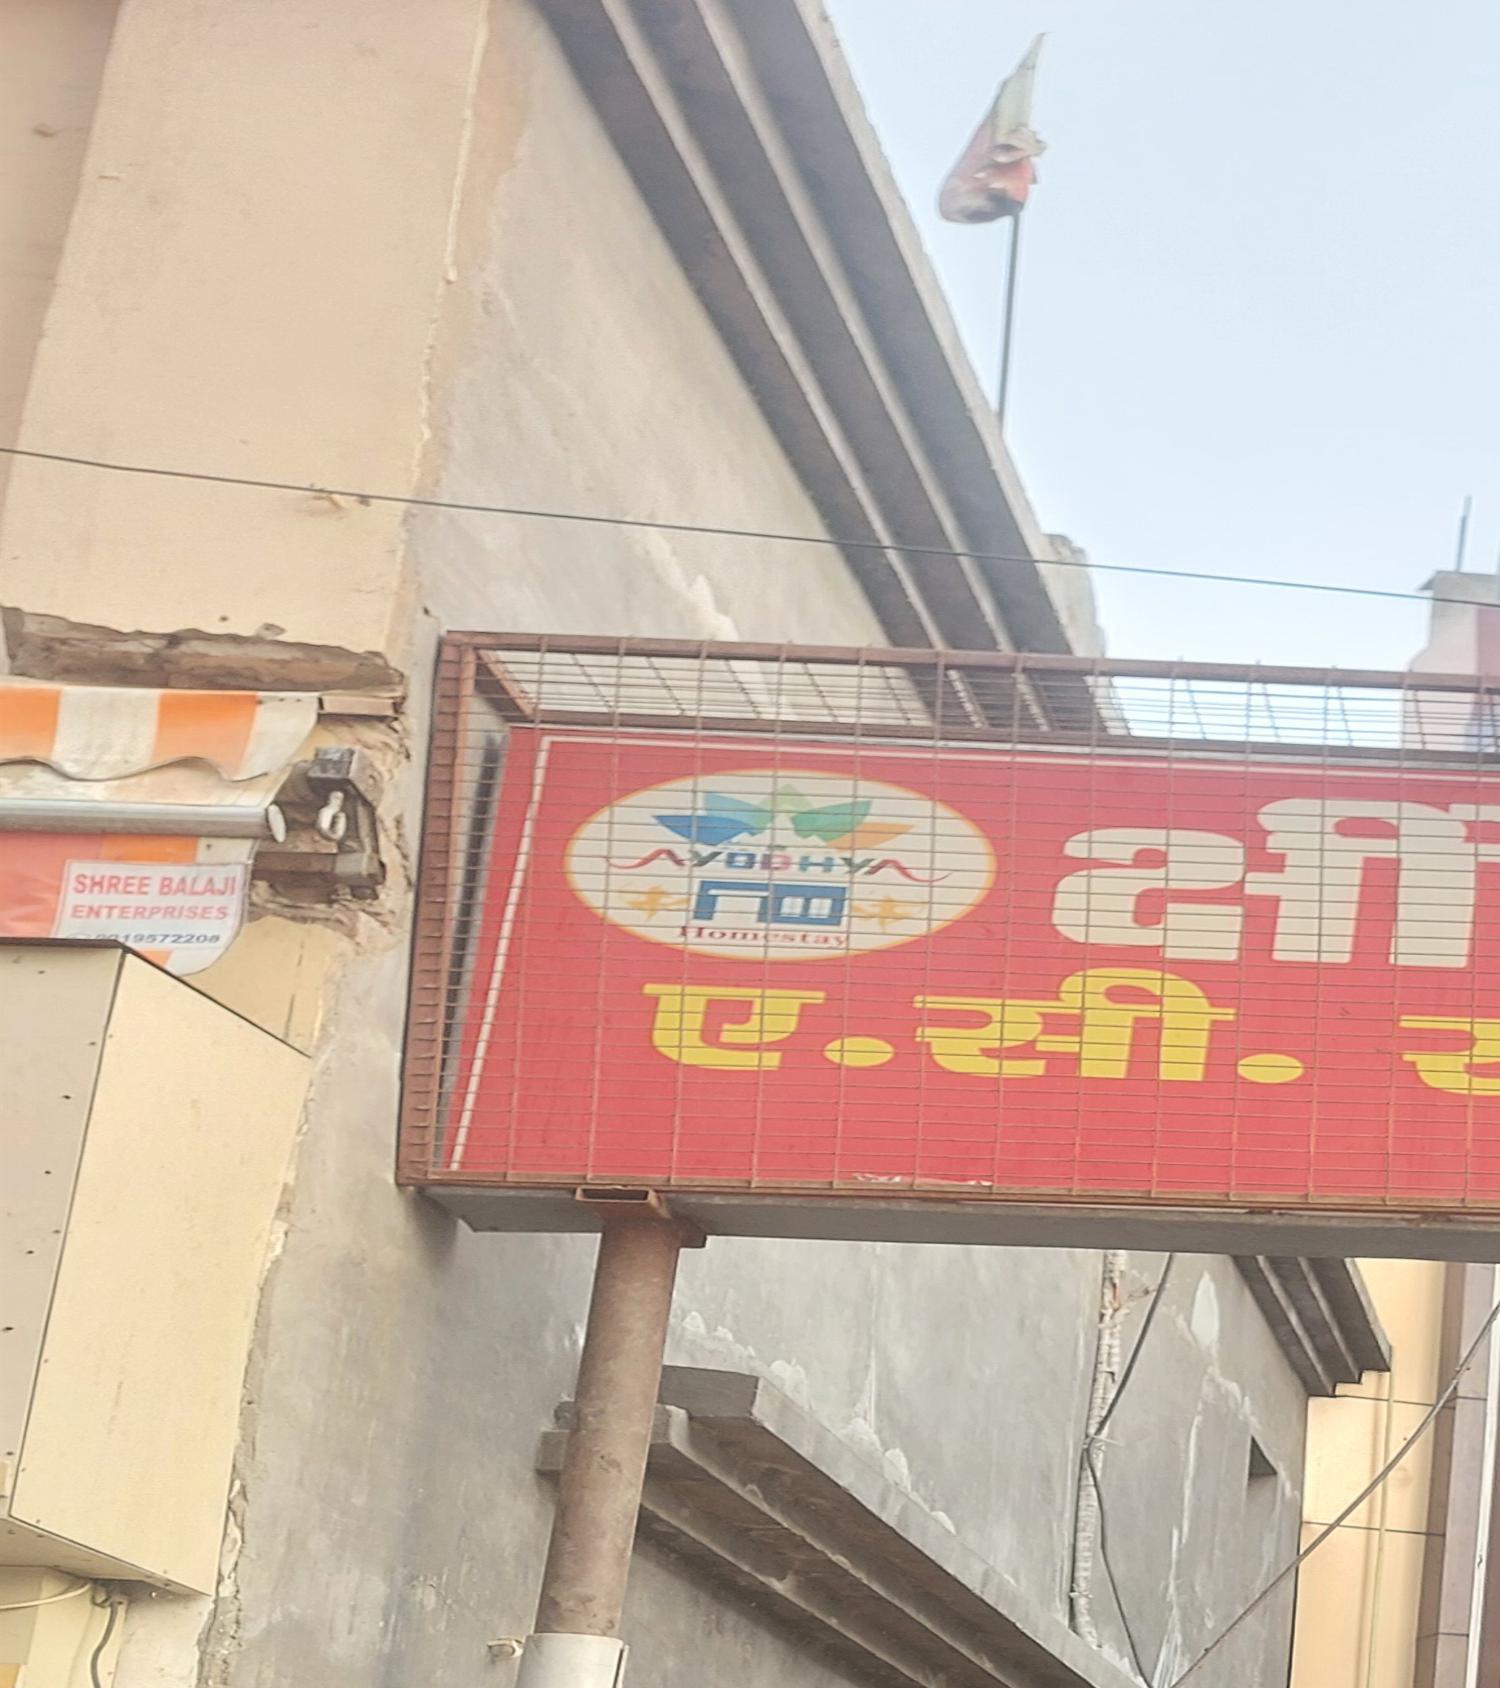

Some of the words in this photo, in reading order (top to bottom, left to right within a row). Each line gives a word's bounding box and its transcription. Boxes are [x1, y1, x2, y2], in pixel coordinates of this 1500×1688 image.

[607, 846, 952, 884] AYODHYA
[74, 873, 151, 895] SHREE
[158, 874, 237, 896] BALAJI
[71, 903, 229, 921] ENTERPRISES
[678, 924, 849, 948] Homestay
